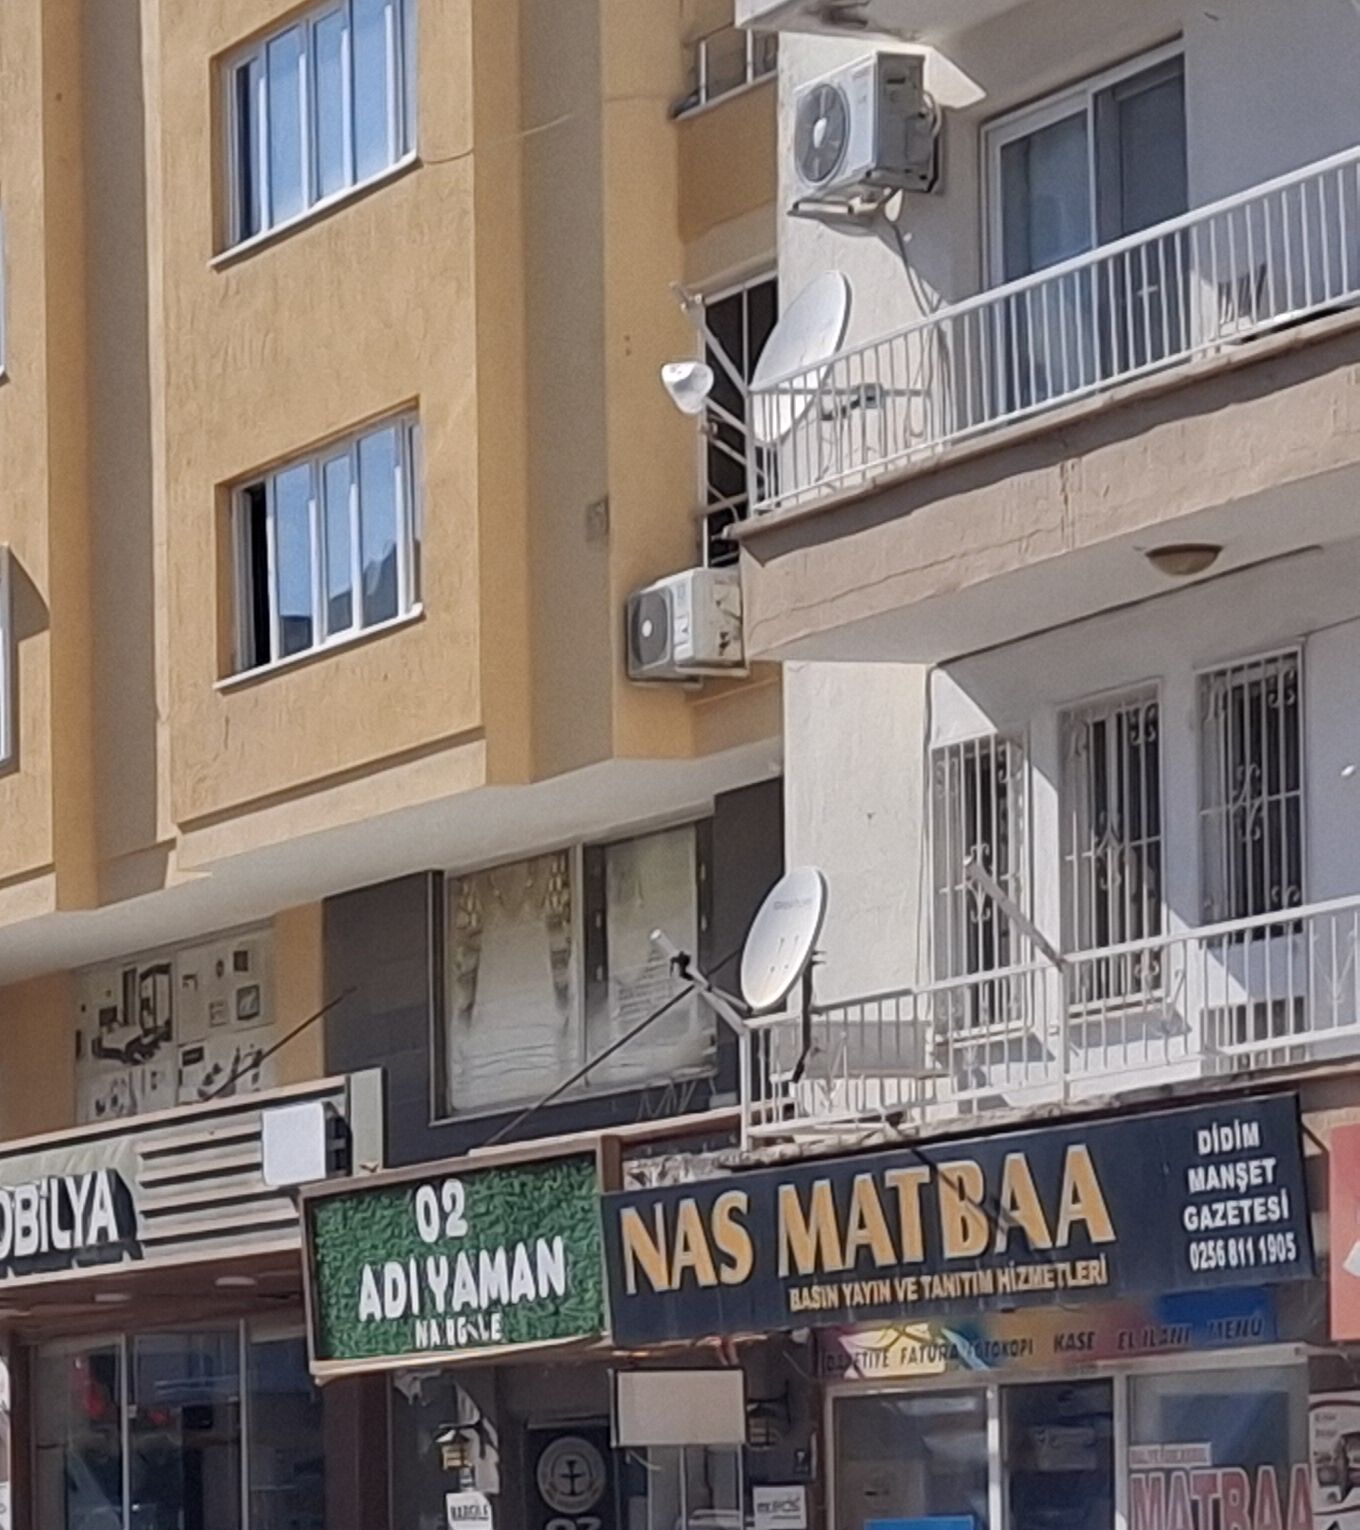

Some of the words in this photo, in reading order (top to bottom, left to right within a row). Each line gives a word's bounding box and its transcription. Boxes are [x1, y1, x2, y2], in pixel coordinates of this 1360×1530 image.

[1197, 1118, 1261, 1156] DİDİM
[1187, 1157, 1277, 1194] MANŞET
[414, 1178, 470, 1244] 02
[620, 1191, 755, 1296] NAS
[778, 1143, 1118, 1279] MATBAA
[1183, 1187, 1290, 1232] GAZETESİ
[1189, 1239, 1226, 1272] 0256
[1228, 1236, 1255, 1267] 811
[1258, 1231, 1297, 1264] 1905
[358, 1235, 566, 1322] ADIYAMAN
[789, 1283, 839, 1312] BASIN
[841, 1279, 891, 1309] YAYIN
[894, 1275, 919, 1301] VE
[921, 1269, 994, 1300] TANITIM
[997, 1252, 1108, 1294] HİZMETLERİ
